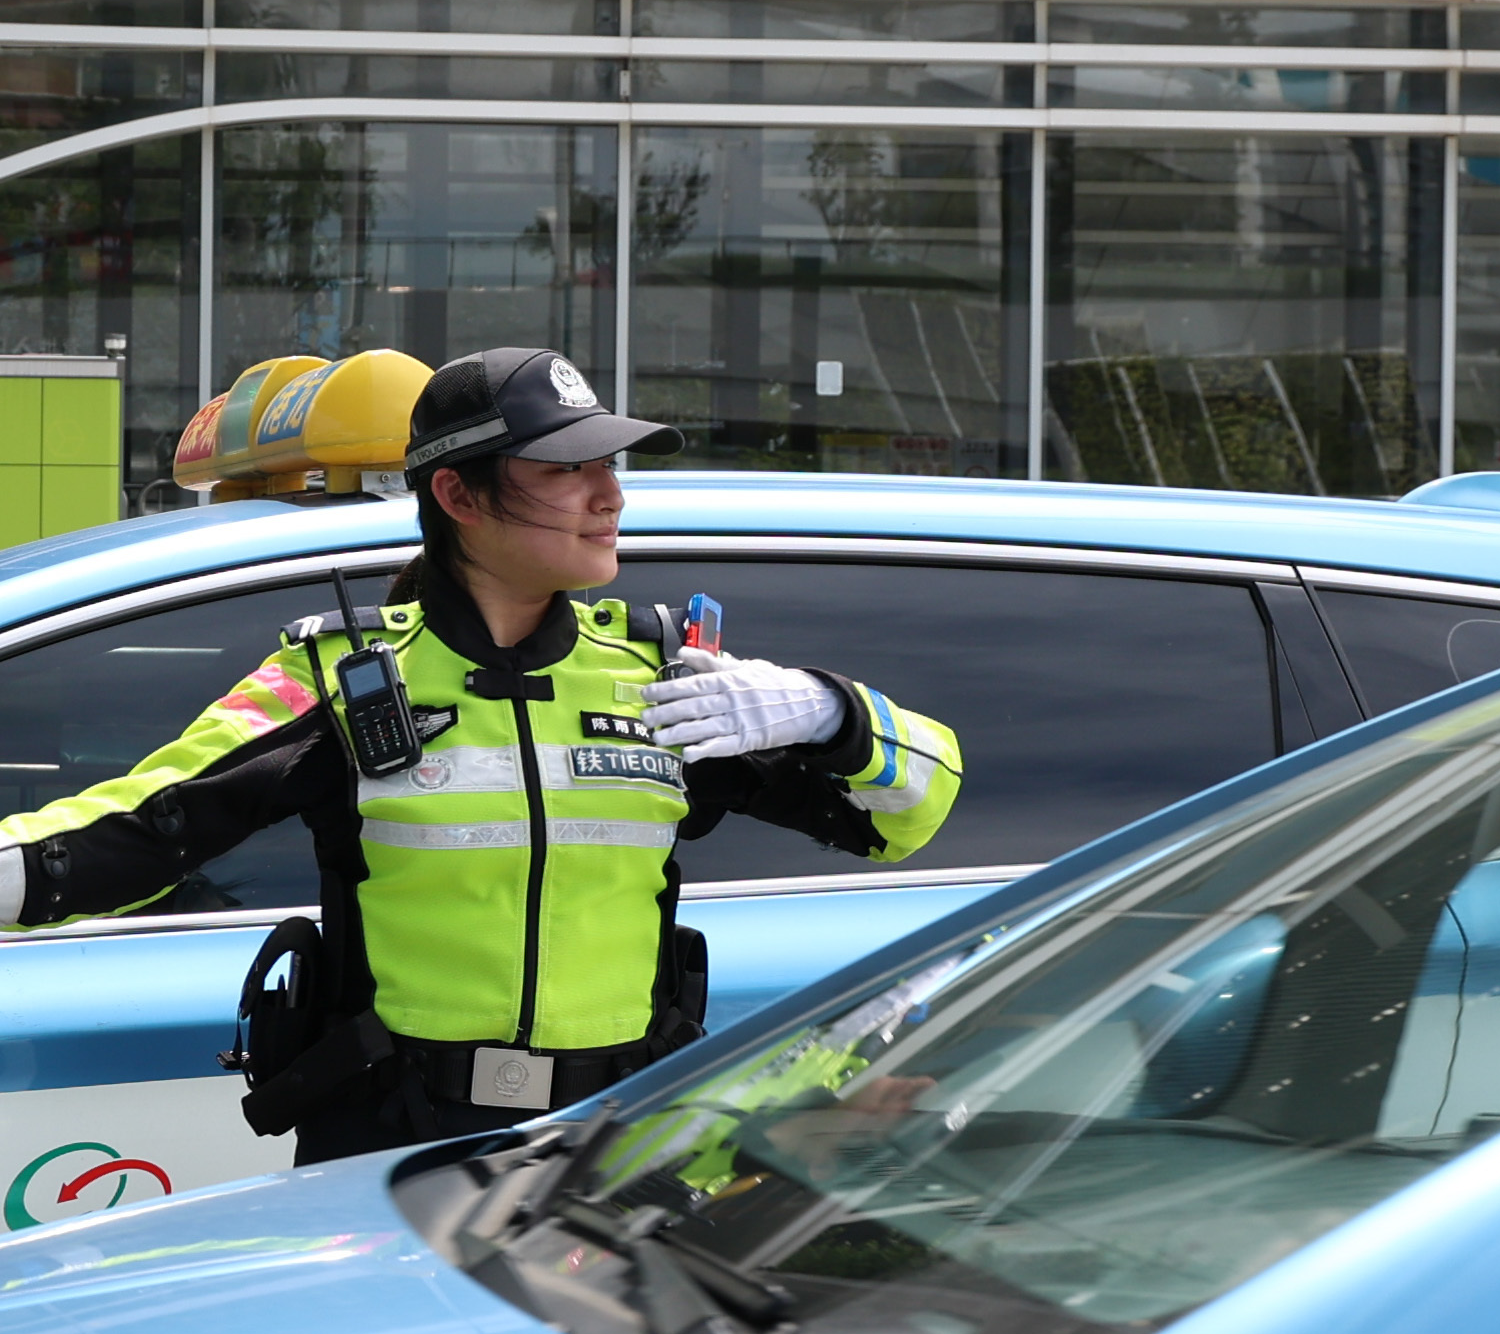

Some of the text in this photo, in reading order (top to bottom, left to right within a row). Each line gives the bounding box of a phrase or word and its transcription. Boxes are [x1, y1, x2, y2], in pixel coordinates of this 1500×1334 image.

[420, 440, 447, 460] POLICE
[577, 749, 604, 772] 铁
[605, 753, 663, 775] TIEQI
